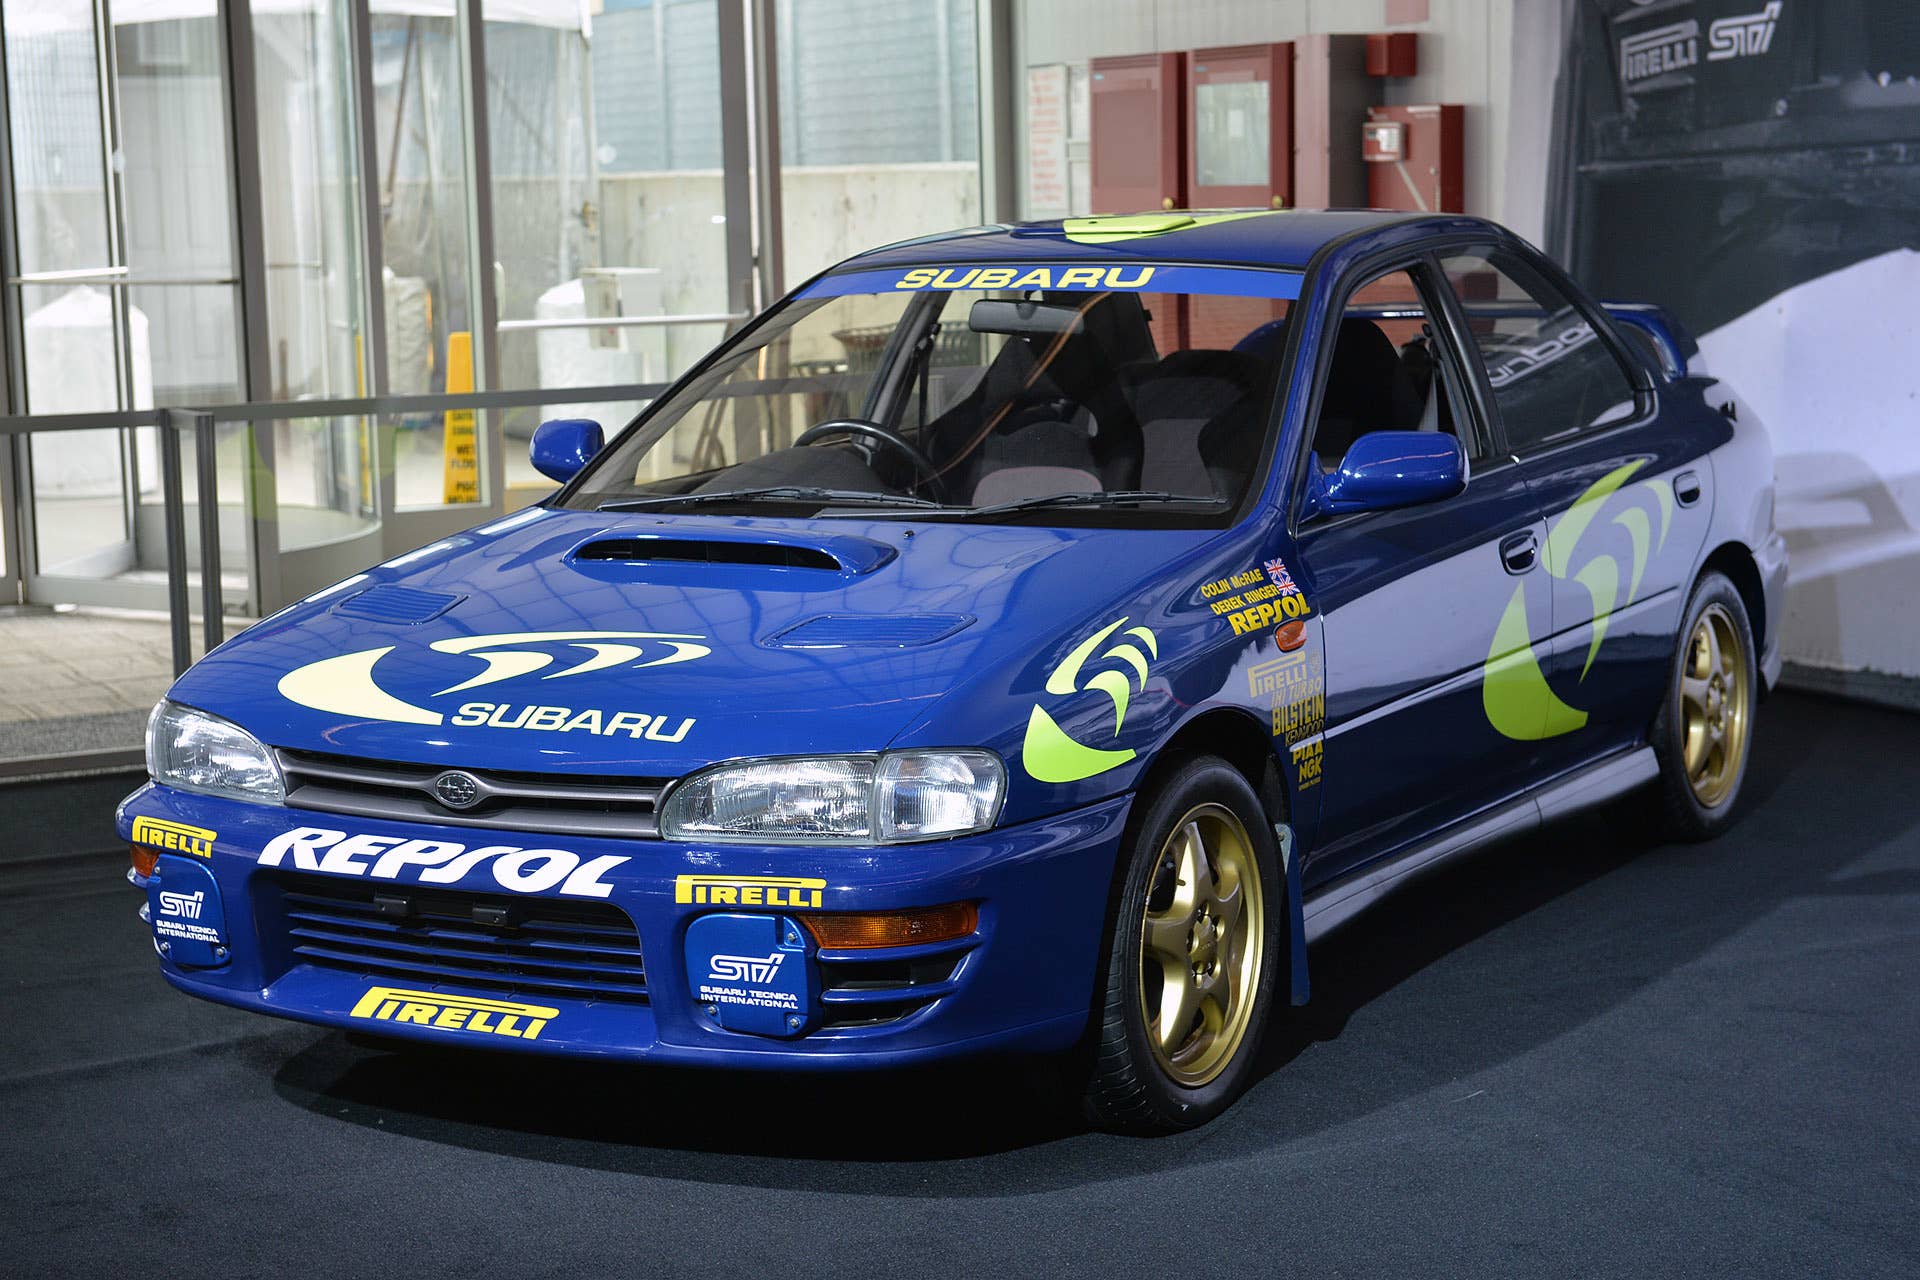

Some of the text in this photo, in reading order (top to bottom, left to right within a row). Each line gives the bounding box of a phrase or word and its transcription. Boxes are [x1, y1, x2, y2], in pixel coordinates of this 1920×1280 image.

[1620, 19, 1699, 81] PIRELLI
[895, 267, 1156, 289] SUBARU
[1201, 568, 1264, 598] COLIN McRAE
[1210, 583, 1280, 615] DEREK RINGER
[1227, 592, 1311, 636] REPSOL
[1247, 650, 1307, 698] PIRELLI
[1288, 676, 1323, 702] TURBO
[451, 702, 697, 743] SUBARU
[1272, 692, 1324, 736] BILSTEIN
[1285, 718, 1325, 747] KENWOOD
[1292, 739, 1323, 765] PIAA
[1298, 754, 1322, 783] NGK
[132, 815, 218, 858] PIRELLI
[257, 826, 632, 898] REPSOL
[675, 874, 828, 908] PIRELLI
[156, 919, 218, 936] SUBARU TECNICA
[157, 927, 220, 943] INTERNATIONAL
[700, 985, 798, 1001] SUBARU TECNICA
[700, 993, 799, 1009] INTERNATIONAL
[350, 986, 560, 1040] PIRELLI
